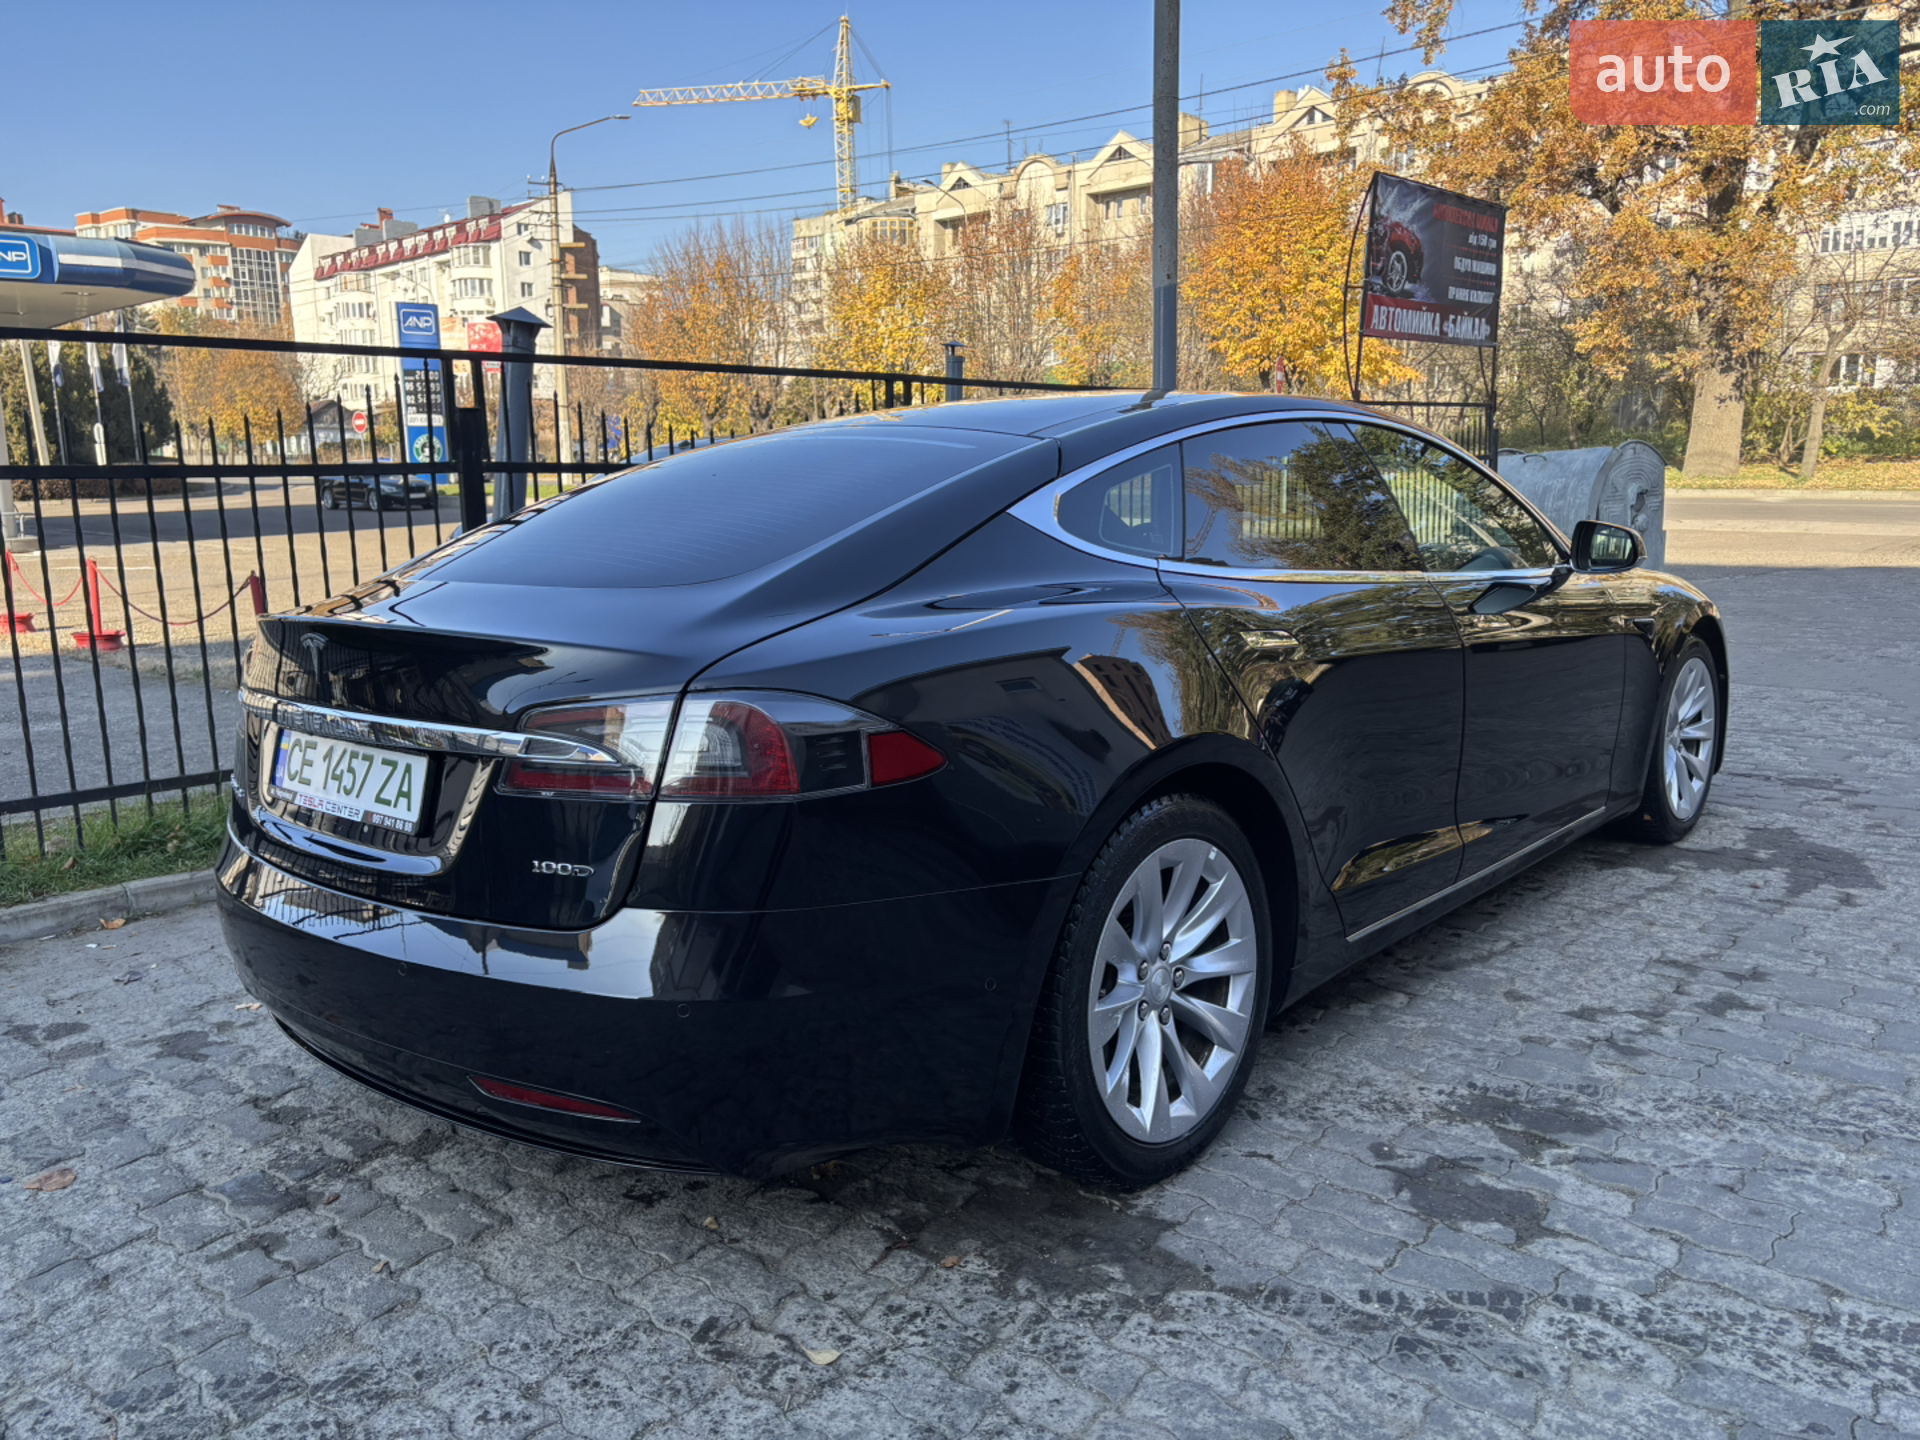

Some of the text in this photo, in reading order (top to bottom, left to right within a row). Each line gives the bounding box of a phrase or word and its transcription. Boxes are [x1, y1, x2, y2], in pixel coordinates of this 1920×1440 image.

[1371, 305, 1440, 336] АВТОМИЙКА
[287, 738, 318, 786] CE
[322, 745, 375, 798] 1457
[374, 757, 412, 812] ZA
[299, 794, 324, 810] TESLA
[324, 801, 361, 819] CENTER
[531, 860, 594, 876] 100D
